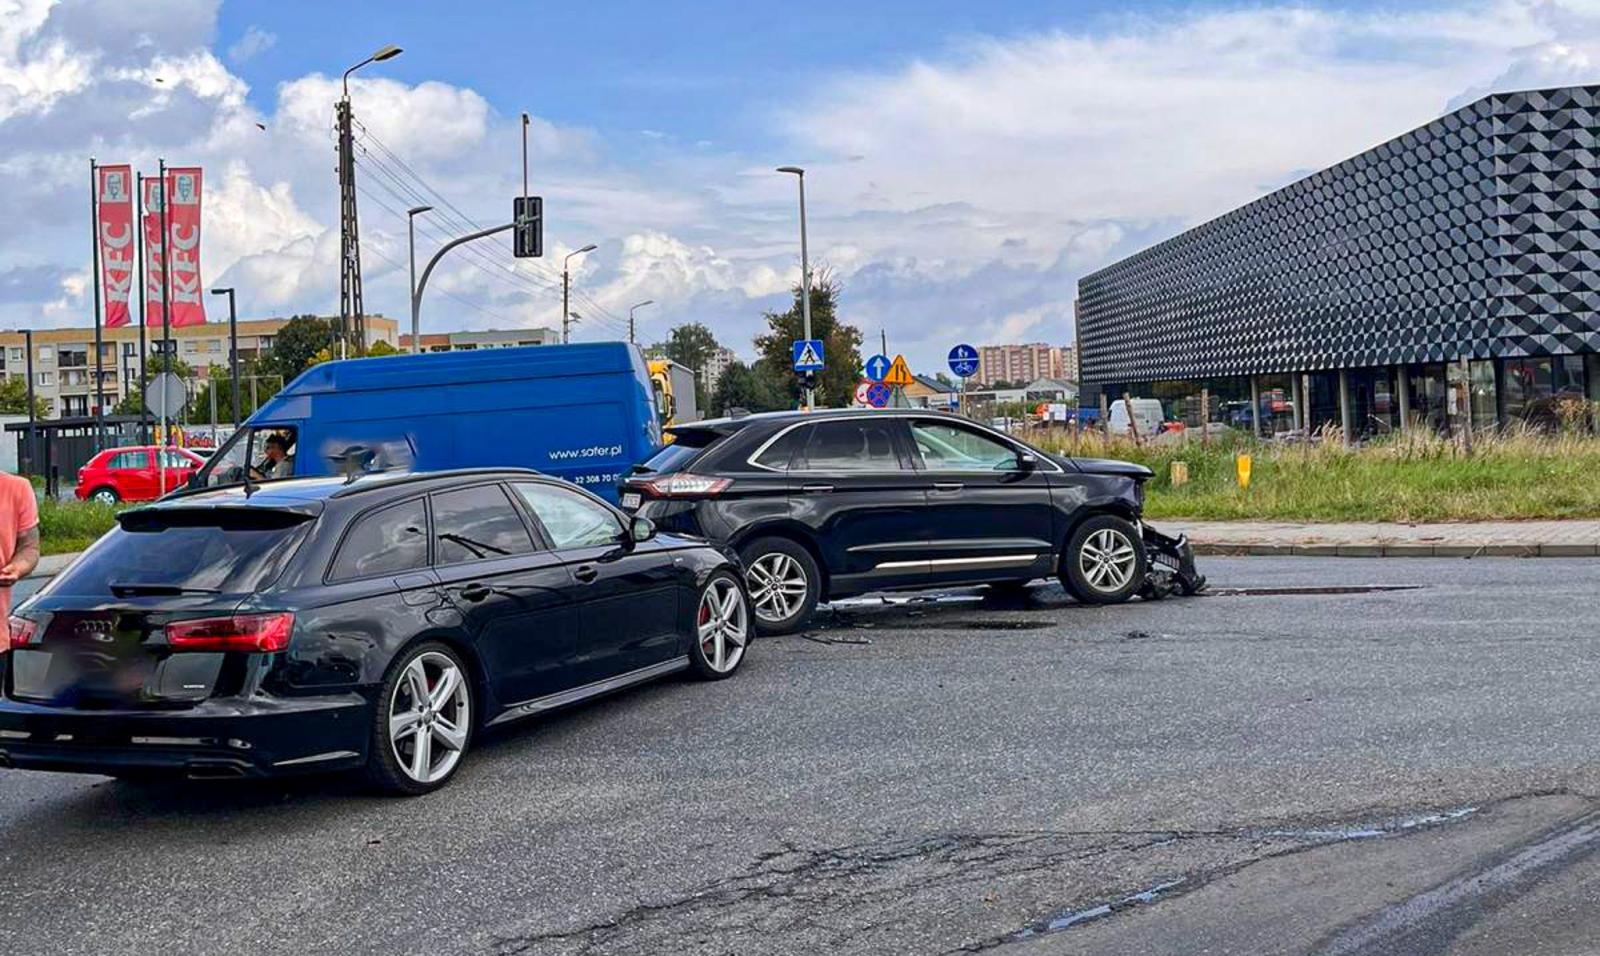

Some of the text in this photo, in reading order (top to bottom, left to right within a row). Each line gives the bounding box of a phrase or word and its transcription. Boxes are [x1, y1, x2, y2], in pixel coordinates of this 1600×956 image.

[102, 223, 132, 302] KFC
[171, 223, 200, 304] KFC
[549, 445, 622, 459] www.safer.pl
